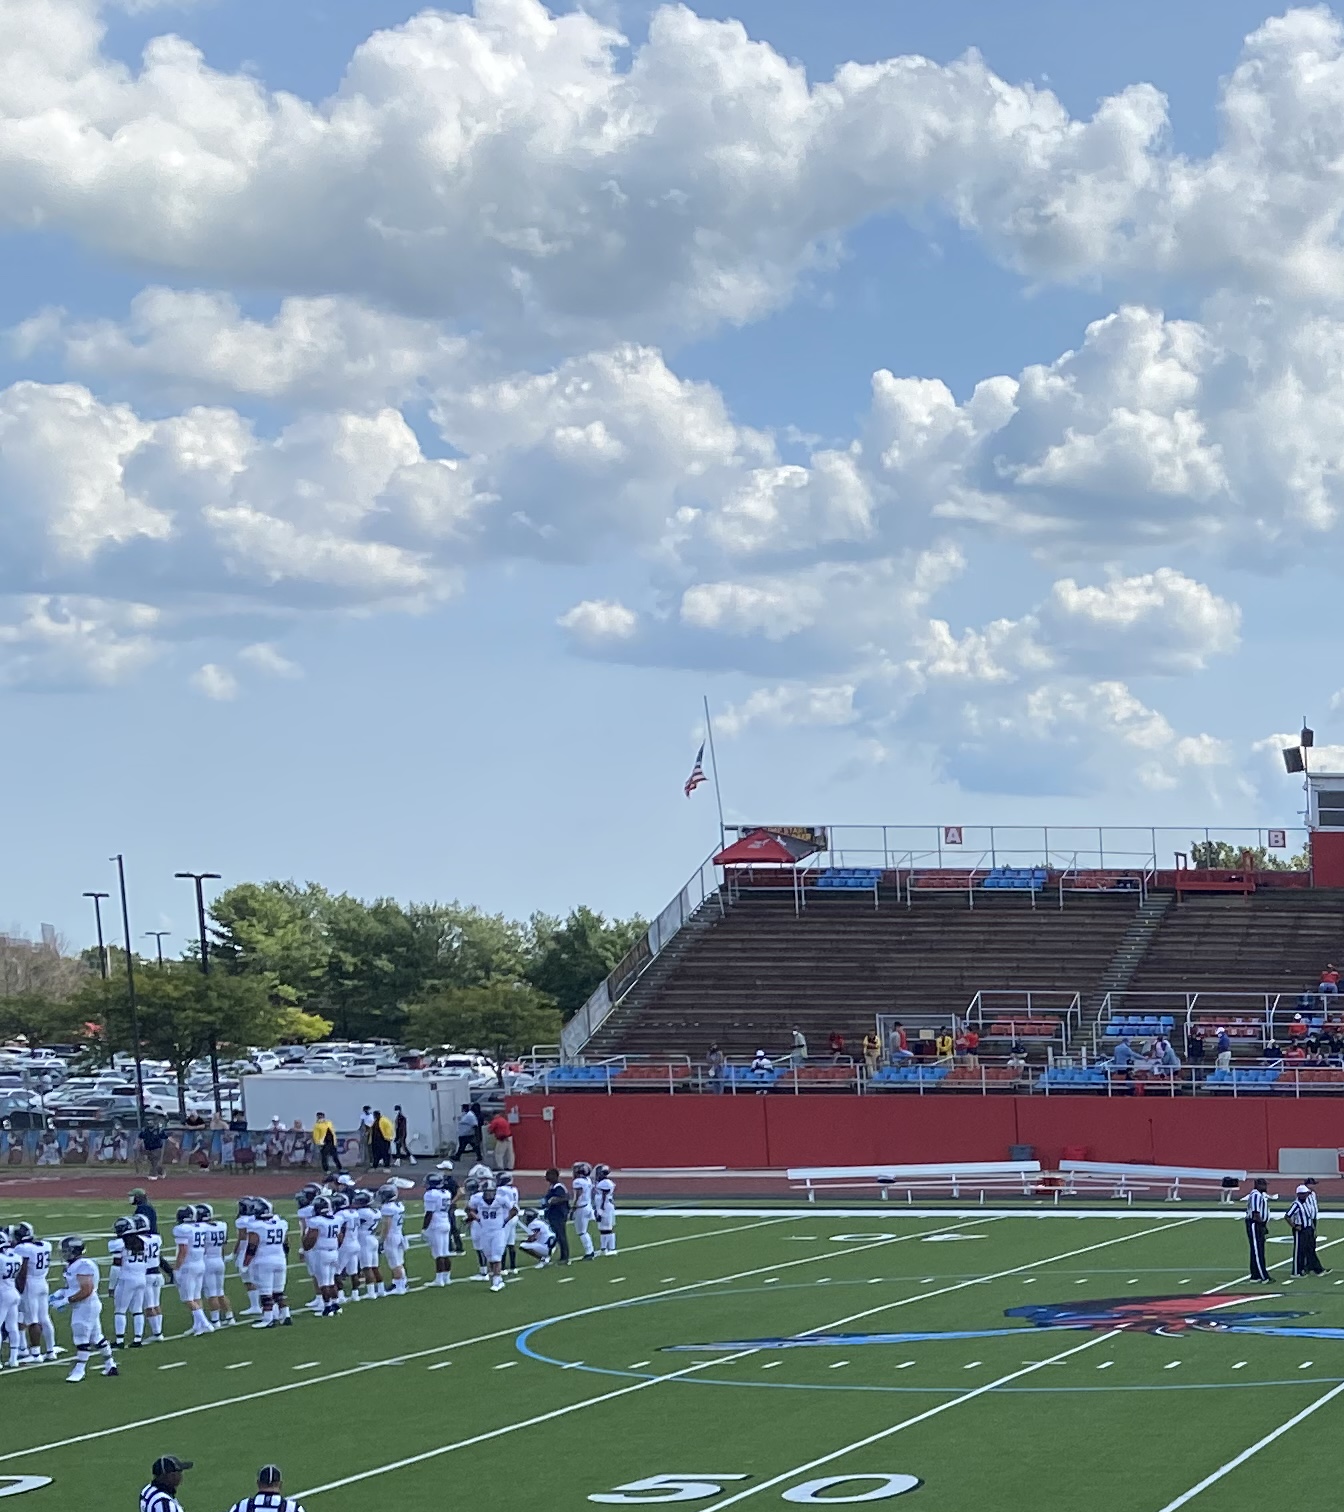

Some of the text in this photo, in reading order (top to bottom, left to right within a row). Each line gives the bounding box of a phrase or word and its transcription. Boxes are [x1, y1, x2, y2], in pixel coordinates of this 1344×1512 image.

[946, 828, 961, 843] A
[1270, 831, 1283, 846] B
[266, 1229, 283, 1246] 59
[588, 1473, 923, 1504] 50
